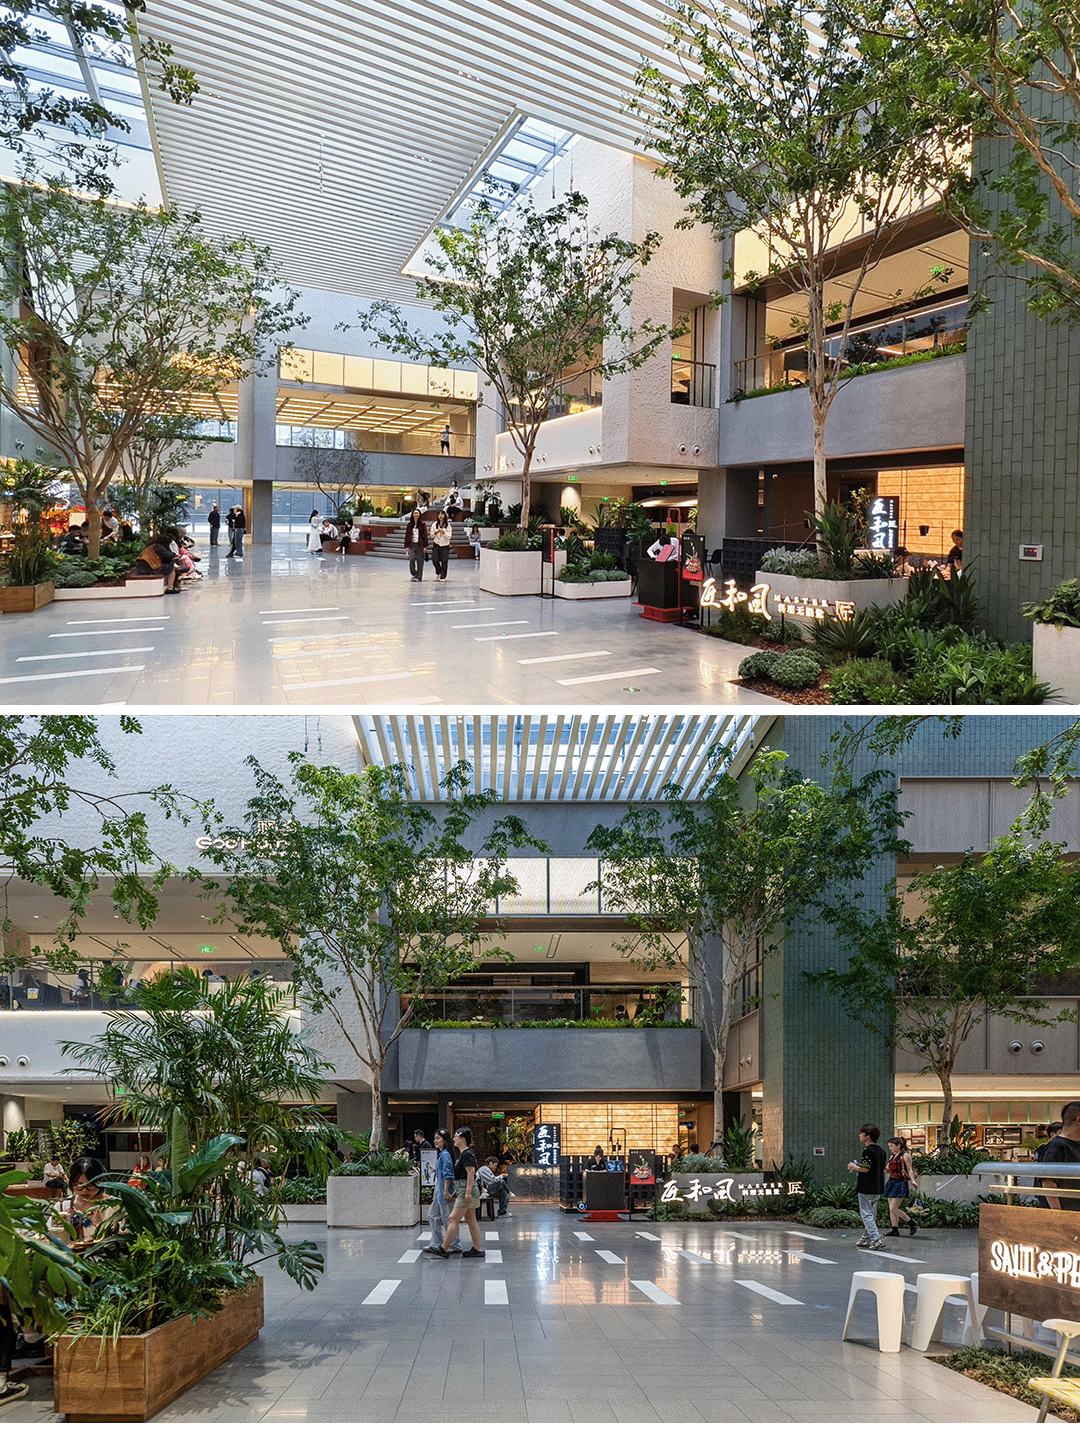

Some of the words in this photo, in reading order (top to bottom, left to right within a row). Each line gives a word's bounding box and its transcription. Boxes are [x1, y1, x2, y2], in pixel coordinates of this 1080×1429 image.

[773, 594, 829, 608] MASTER
[738, 1182, 783, 1190] MASTER
[787, 1181, 805, 1195] 匠
